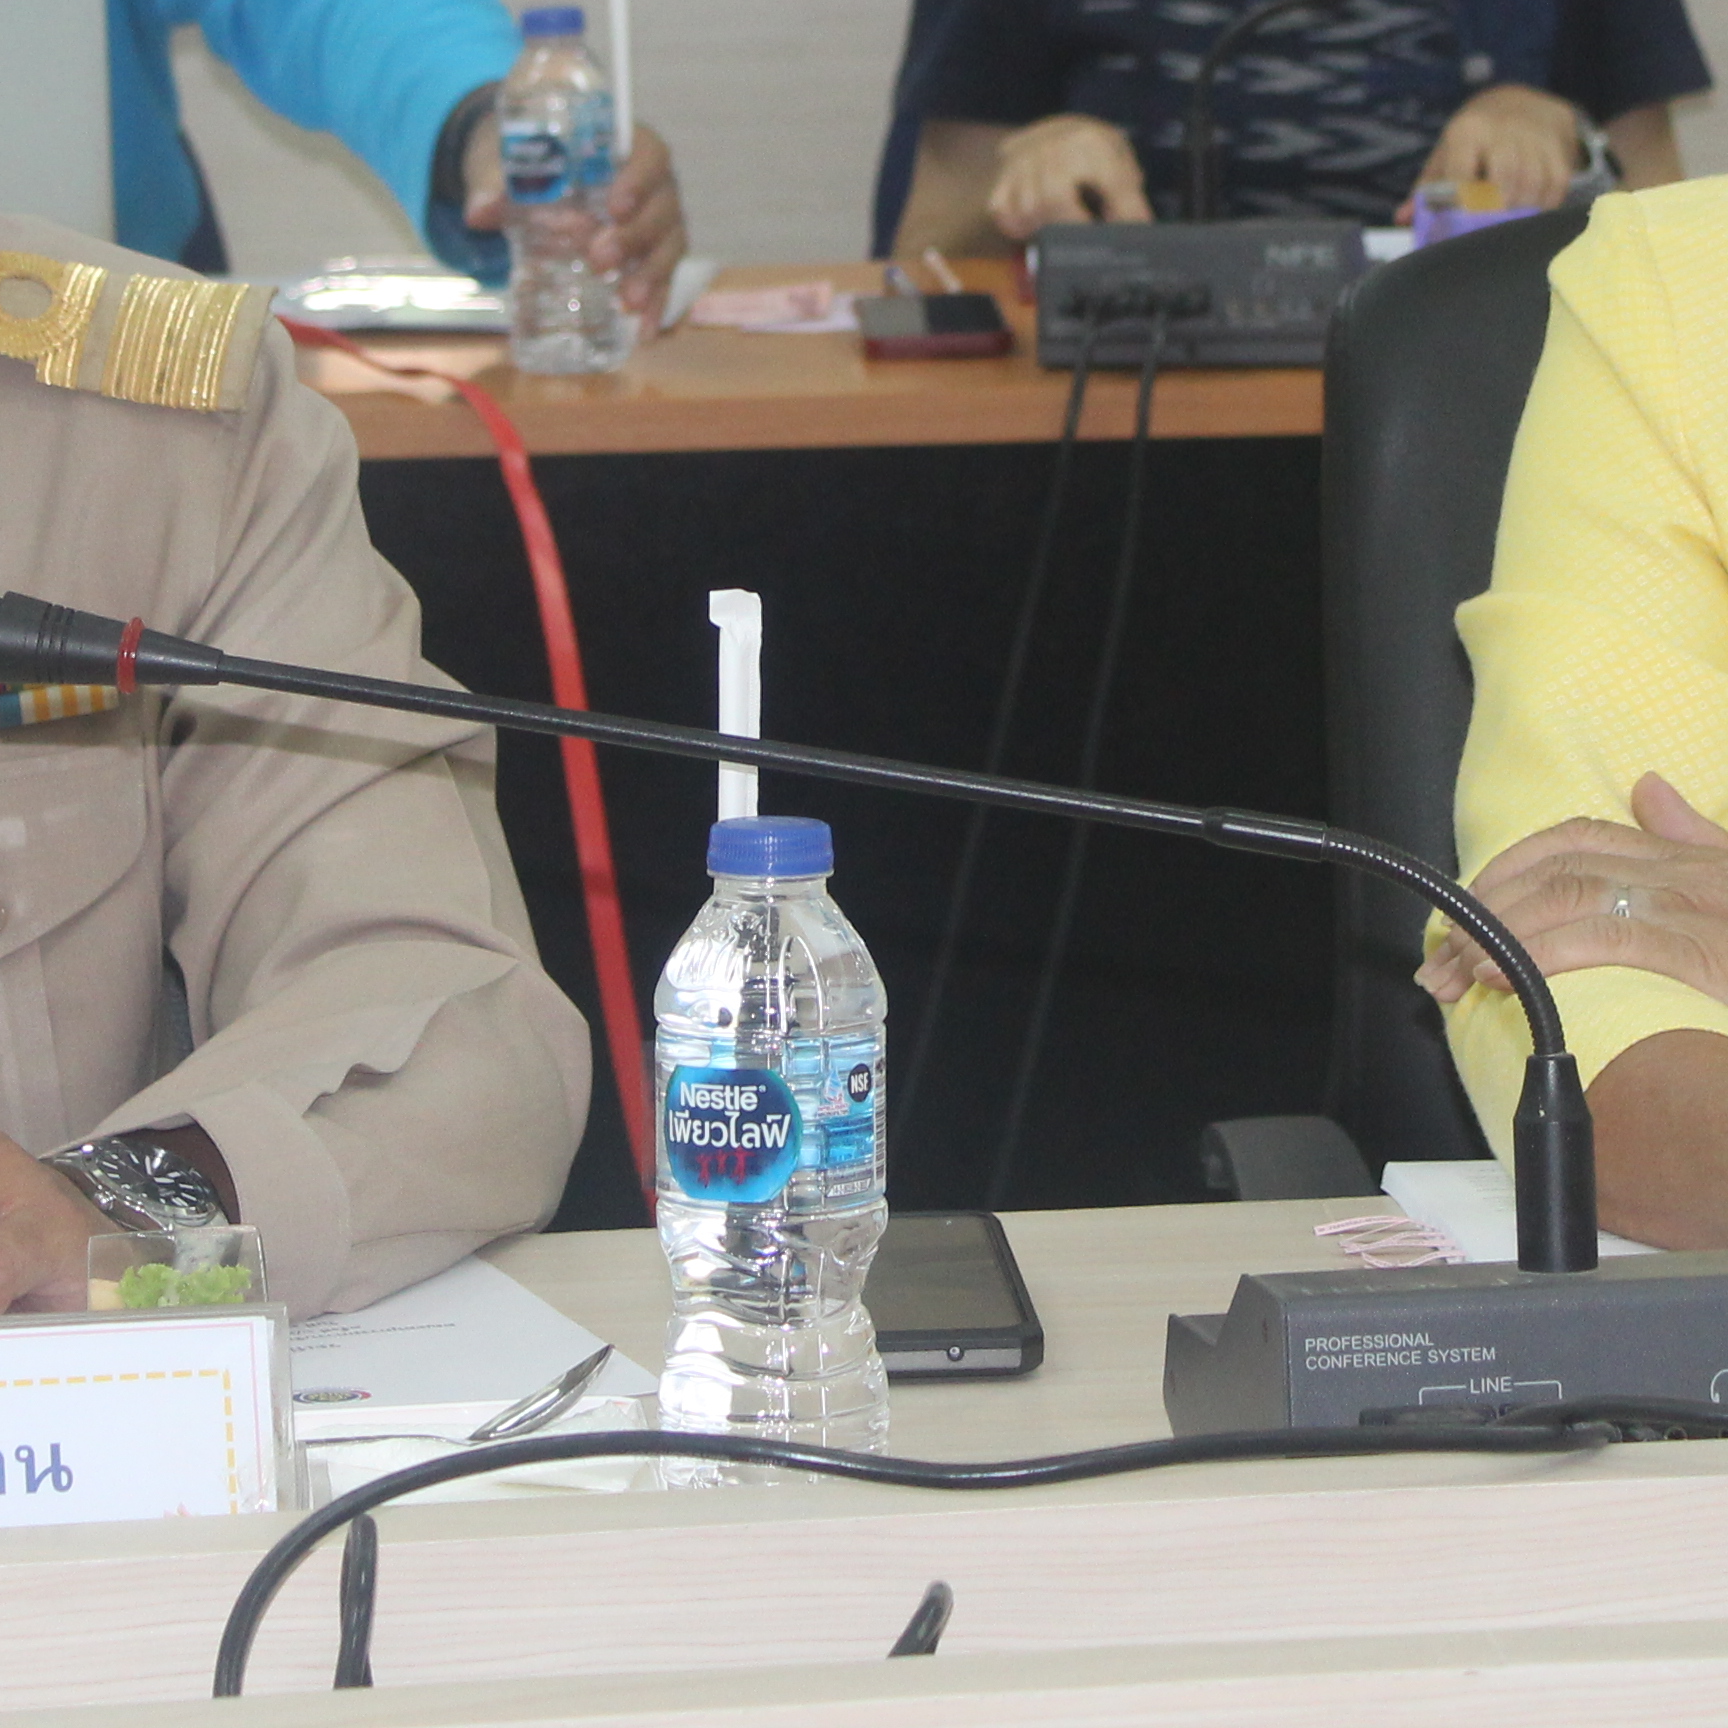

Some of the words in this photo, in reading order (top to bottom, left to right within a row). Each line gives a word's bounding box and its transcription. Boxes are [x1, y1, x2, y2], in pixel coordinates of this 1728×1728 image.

[850, 1072, 869, 1094] NSF
[1305, 1333, 1434, 1352] PROFESSIONAL
[1306, 1350, 1422, 1370] CONFERENCE
[1428, 1347, 1496, 1364] SYSTEM
[1470, 1376, 1513, 1394] LINE
